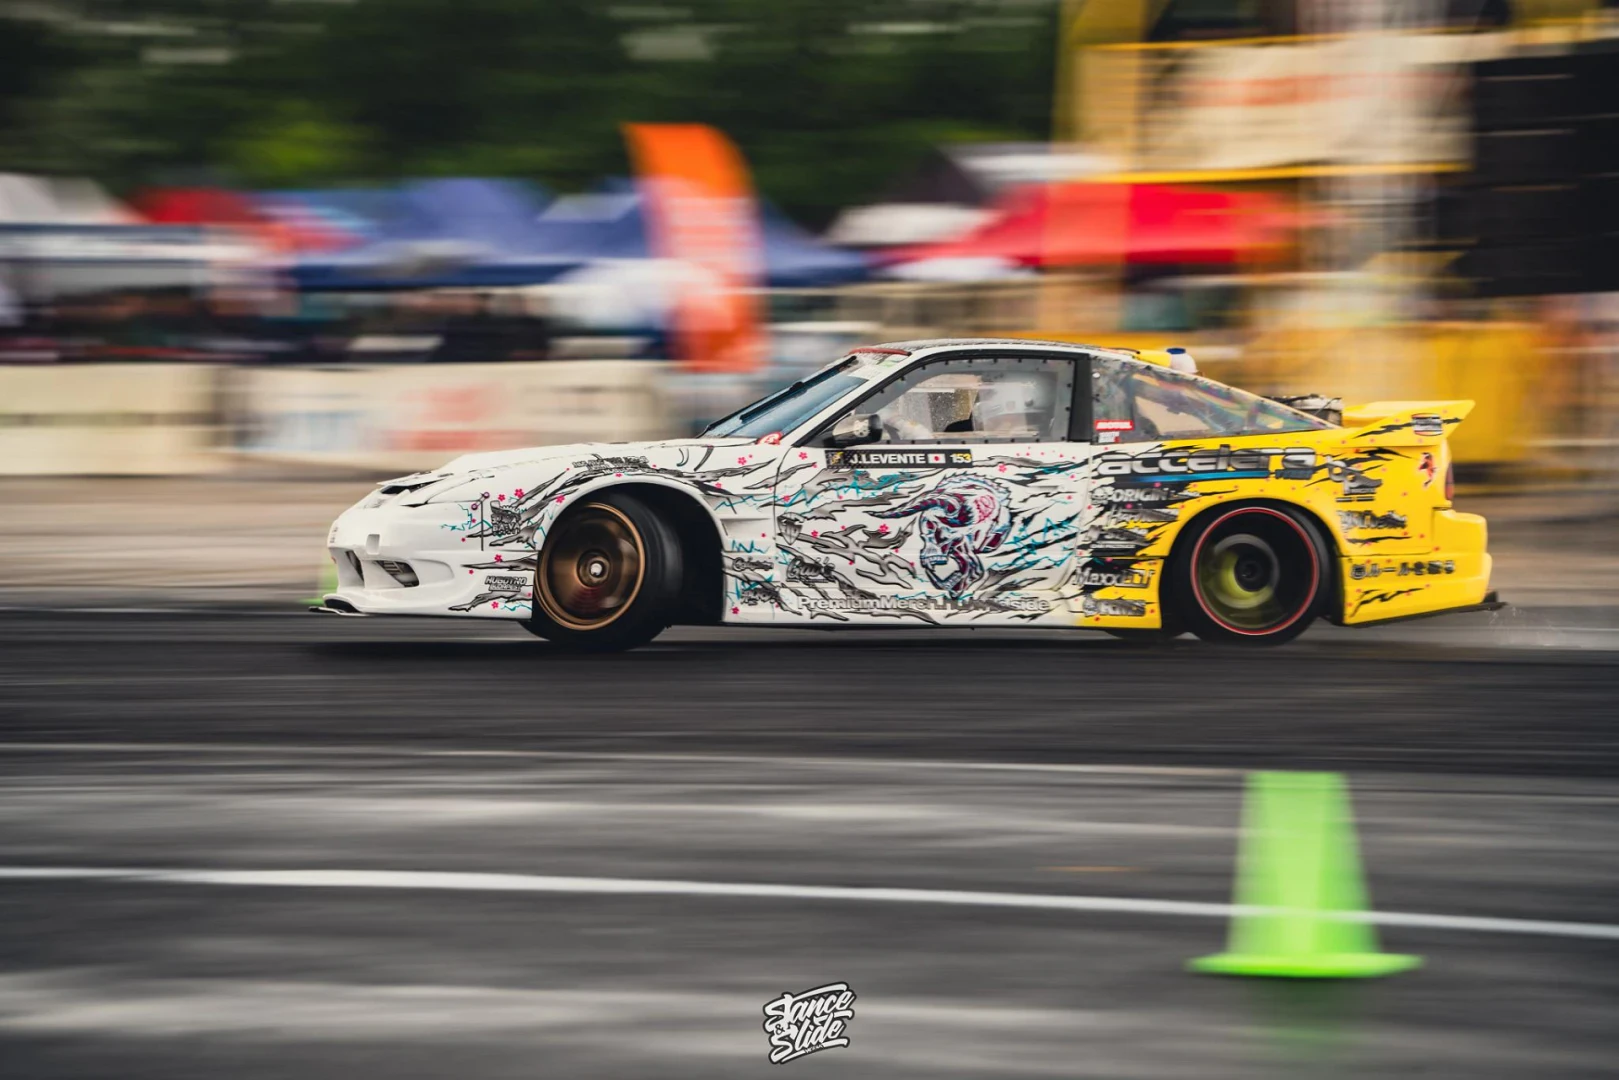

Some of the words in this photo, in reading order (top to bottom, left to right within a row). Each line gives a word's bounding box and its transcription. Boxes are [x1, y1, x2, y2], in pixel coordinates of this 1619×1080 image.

[850, 453, 926, 464] J.LEVENTE
[951, 452, 972, 463] 153
[1097, 445, 1316, 476] accelera
